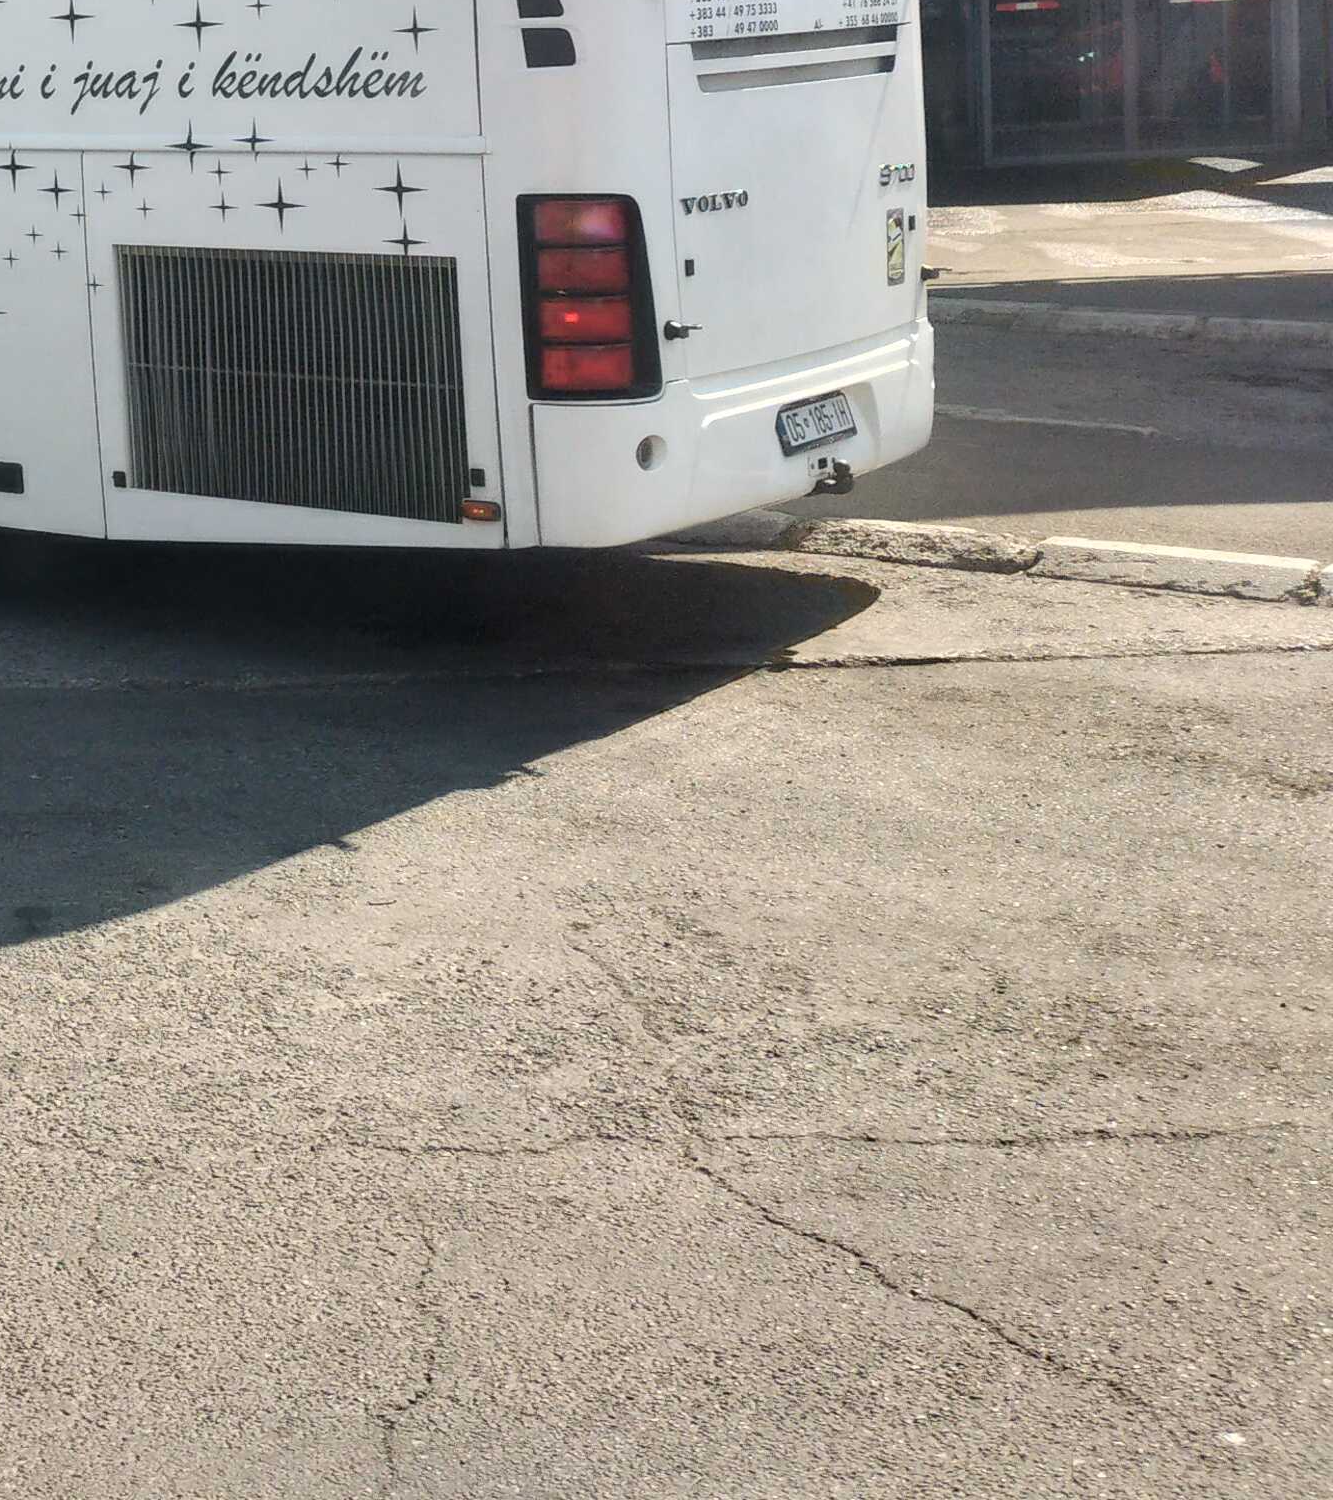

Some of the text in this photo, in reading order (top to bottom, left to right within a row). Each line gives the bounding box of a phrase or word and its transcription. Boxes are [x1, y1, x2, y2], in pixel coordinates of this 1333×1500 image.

[689, 7, 713, 20] +383
[715, 7, 725, 18] 44
[733, 5, 744, 17] 49
[745, 4, 756, 16] 75
[758, 2, 777, 15] 3333
[690, 25, 713, 38] +383
[735, 22, 744, 34] 49
[40, 62, 57, 99] i
[70, 58, 164, 116] juaj
[178, 60, 196, 98] i
[212, 46, 427, 100] këndshëm
[680, 190, 748, 215] VOLVO
[786, 412, 806, 442] 05
